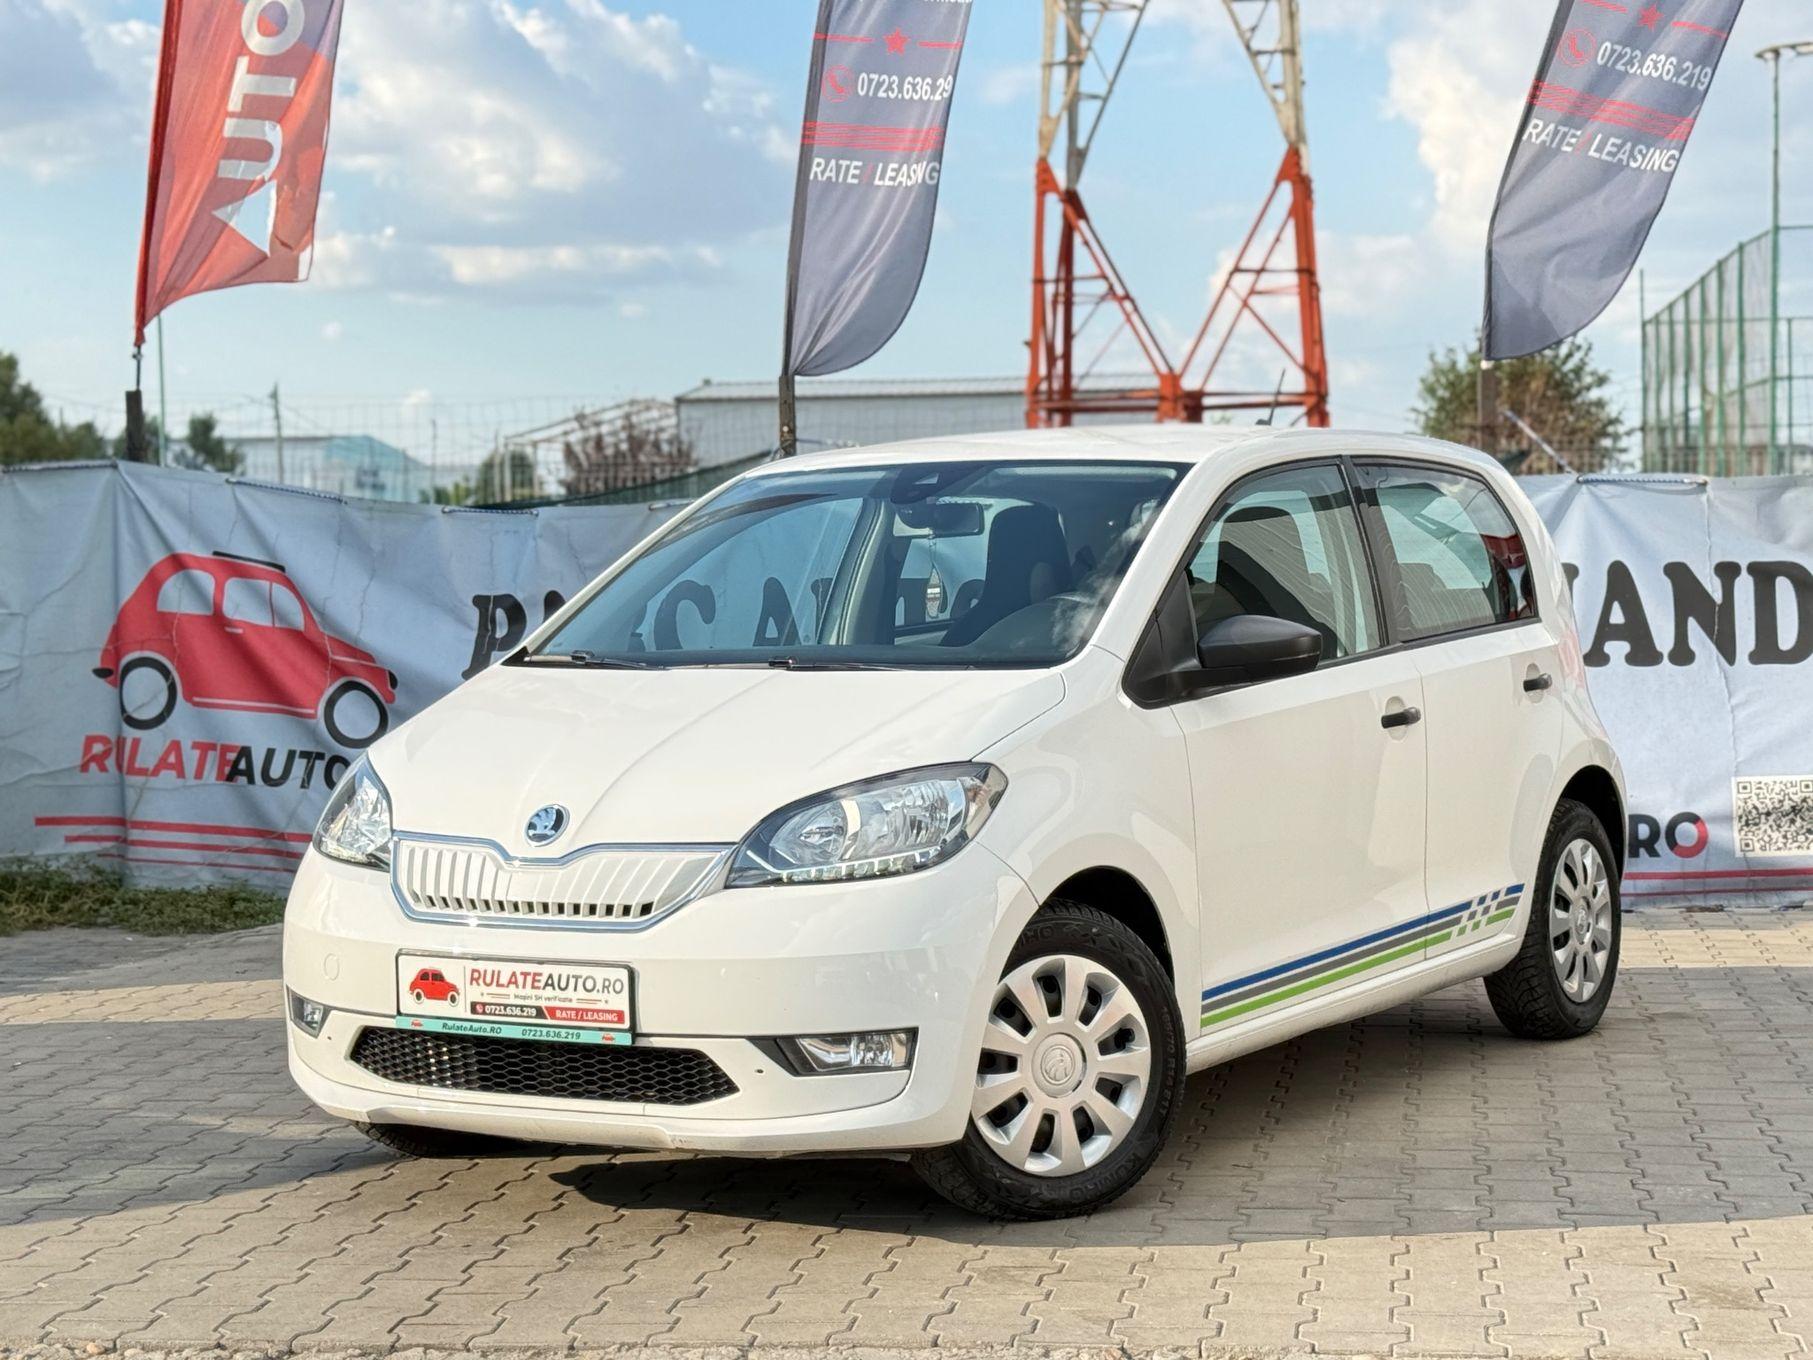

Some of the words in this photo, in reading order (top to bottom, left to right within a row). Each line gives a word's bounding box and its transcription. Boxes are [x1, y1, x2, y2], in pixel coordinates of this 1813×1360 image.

[1596, 41, 1712, 92] 0723.636.219
[857, 72, 953, 101] 0723.636.29
[1522, 118, 1582, 152] RATE
[1588, 133, 1680, 173] LEASING
[809, 157, 863, 185] RATE
[874, 161, 940, 187] LEASNG
[1561, 560, 1813, 667] AND
[469, 968, 624, 994] RULATEAUTO.RO
[485, 1005, 537, 1017] 0723.636.219
[555, 1010, 577, 1020] RATE
[583, 1012, 618, 1022] LEASING
[442, 1022, 502, 1035] RulateAuto.RO
[521, 1028, 581, 1040] 0723.636.219
